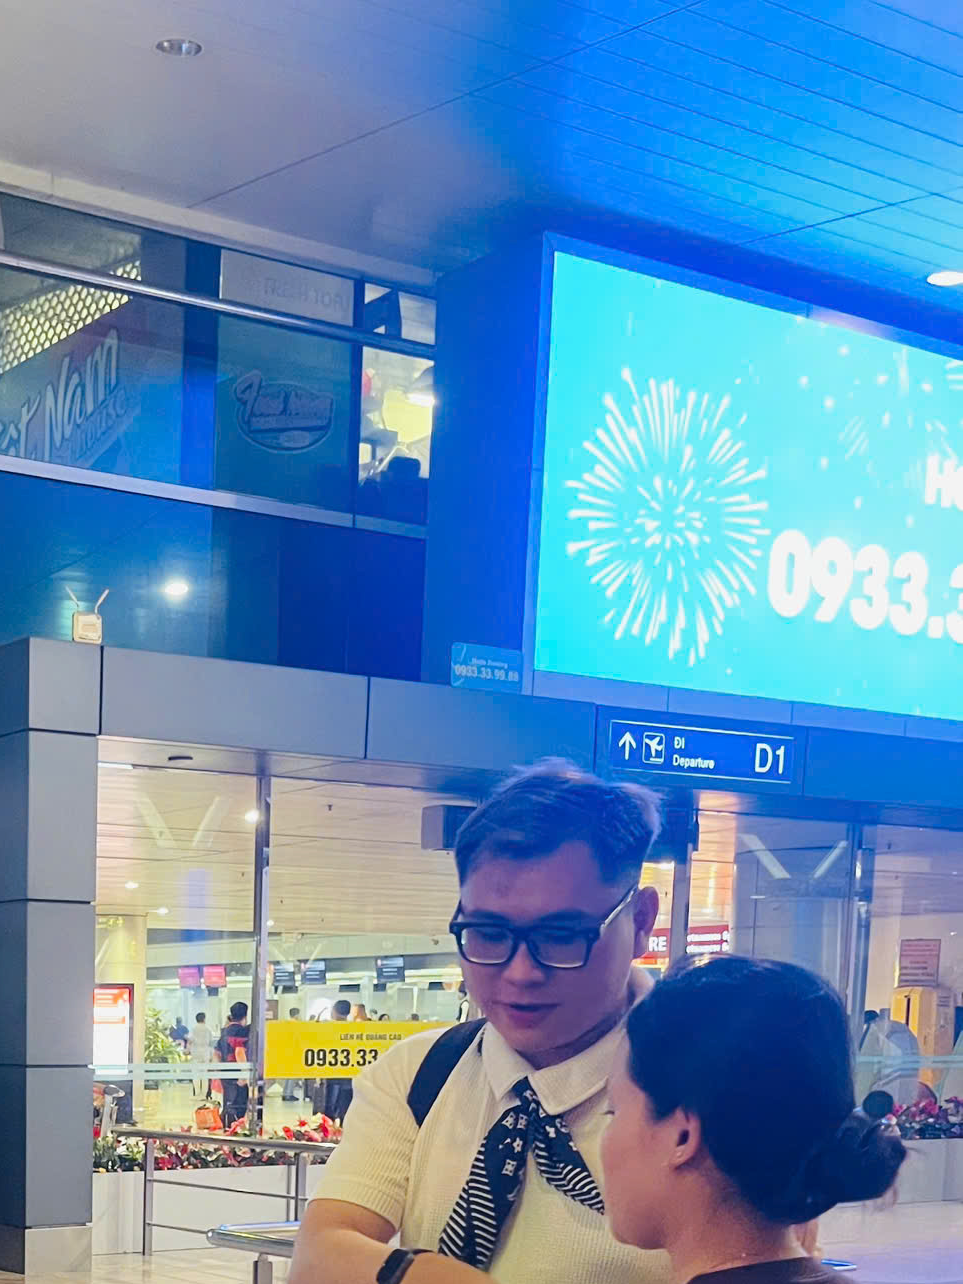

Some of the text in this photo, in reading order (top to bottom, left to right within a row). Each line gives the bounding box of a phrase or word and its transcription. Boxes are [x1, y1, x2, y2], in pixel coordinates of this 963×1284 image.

[673, 736, 685, 749] ĐI
[672, 754, 715, 770] Departure
[754, 743, 785, 775] D1
